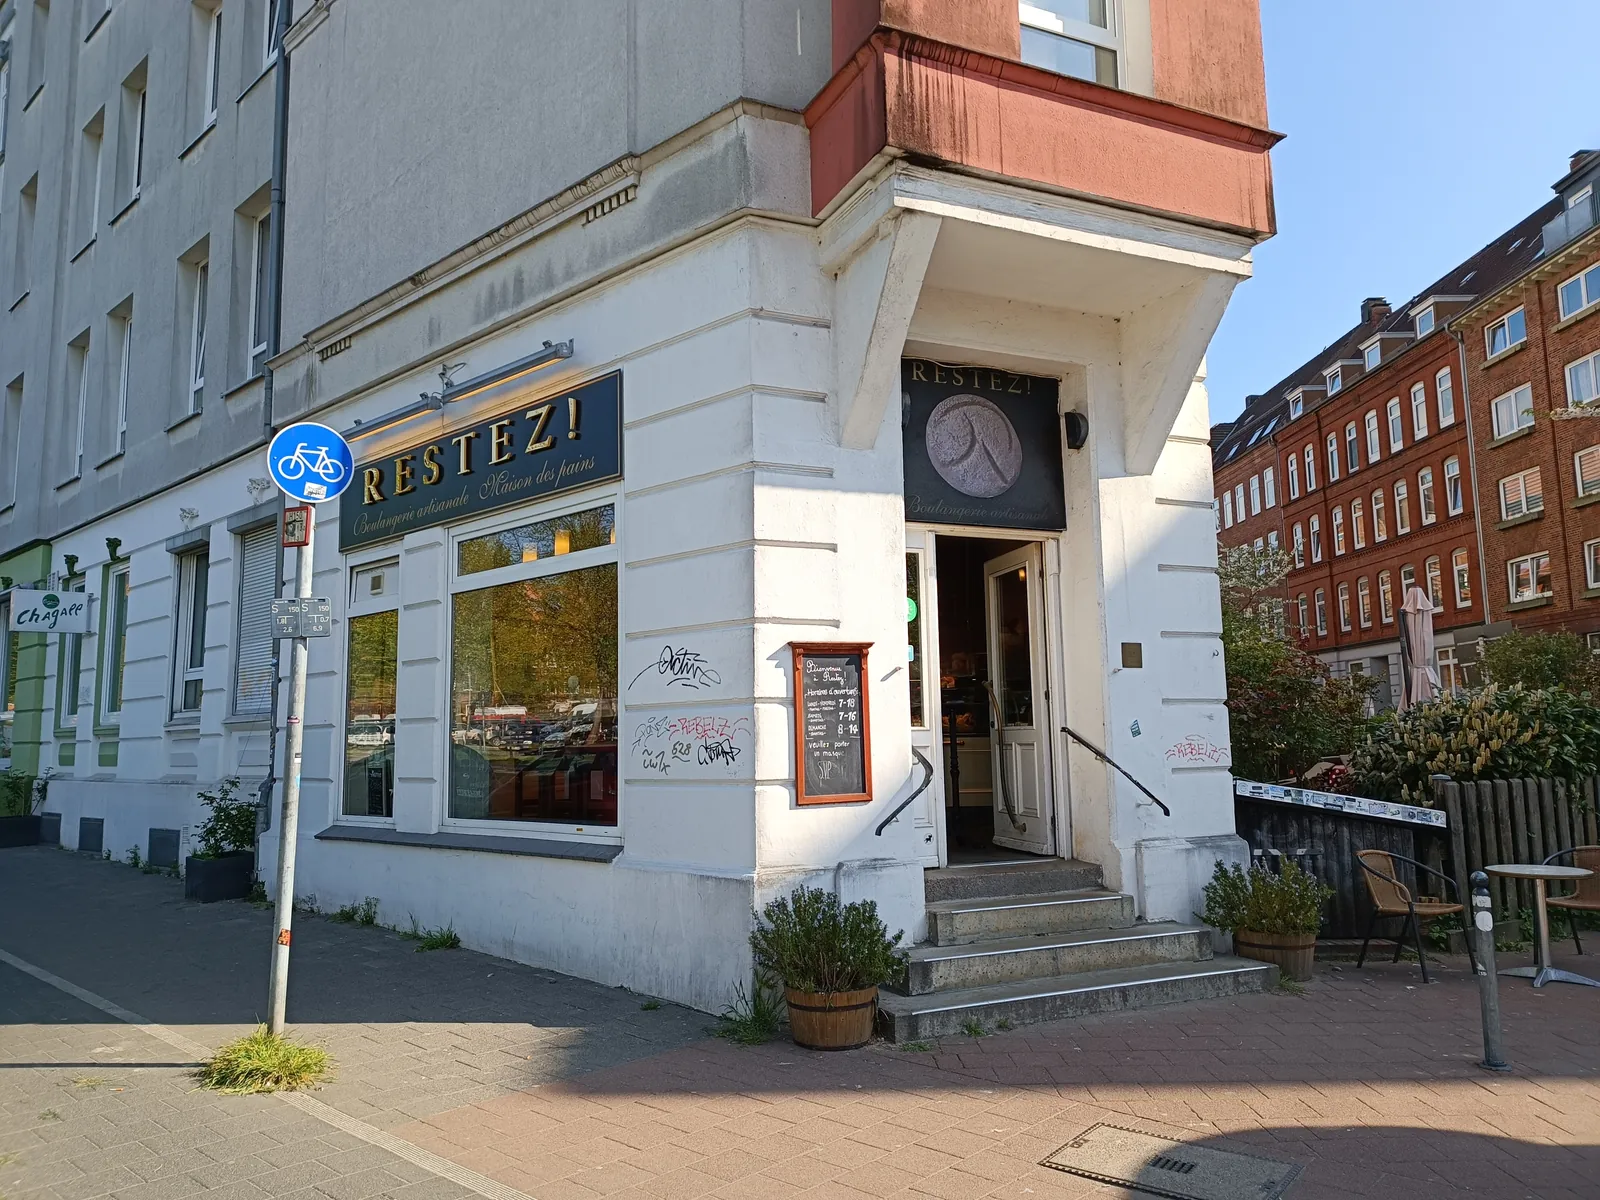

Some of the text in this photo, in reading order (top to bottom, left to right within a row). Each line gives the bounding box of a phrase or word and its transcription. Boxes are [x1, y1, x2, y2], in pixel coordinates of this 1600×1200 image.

[911, 361, 1031, 395] RESTEZ!
[362, 397, 578, 505] RESTEZ!
[353, 454, 595, 536] Boulangerie artisanale Maison des pains
[907, 494, 988, 521] Boulangerie
